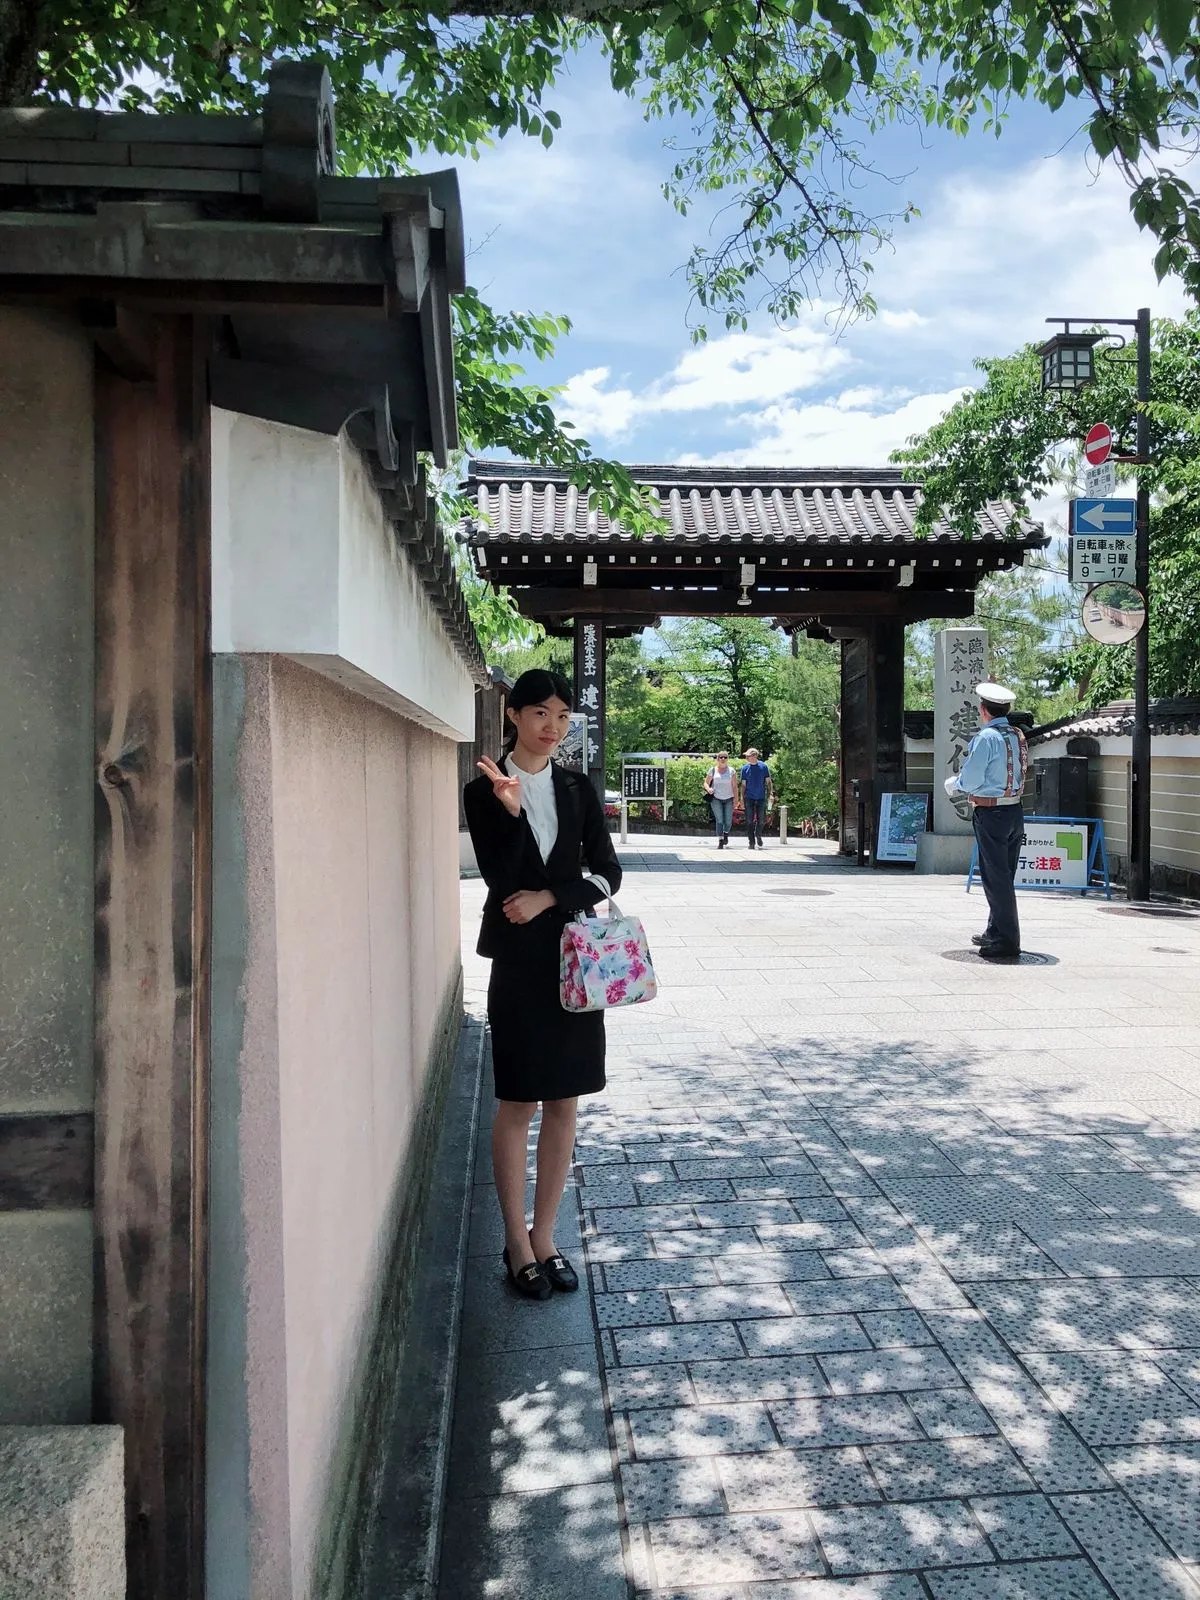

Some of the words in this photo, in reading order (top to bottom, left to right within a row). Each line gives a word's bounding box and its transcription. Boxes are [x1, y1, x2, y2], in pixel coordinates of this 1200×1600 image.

[1076, 539, 1132, 550] 自転車を除く
[950, 637, 967, 693] 大本山
